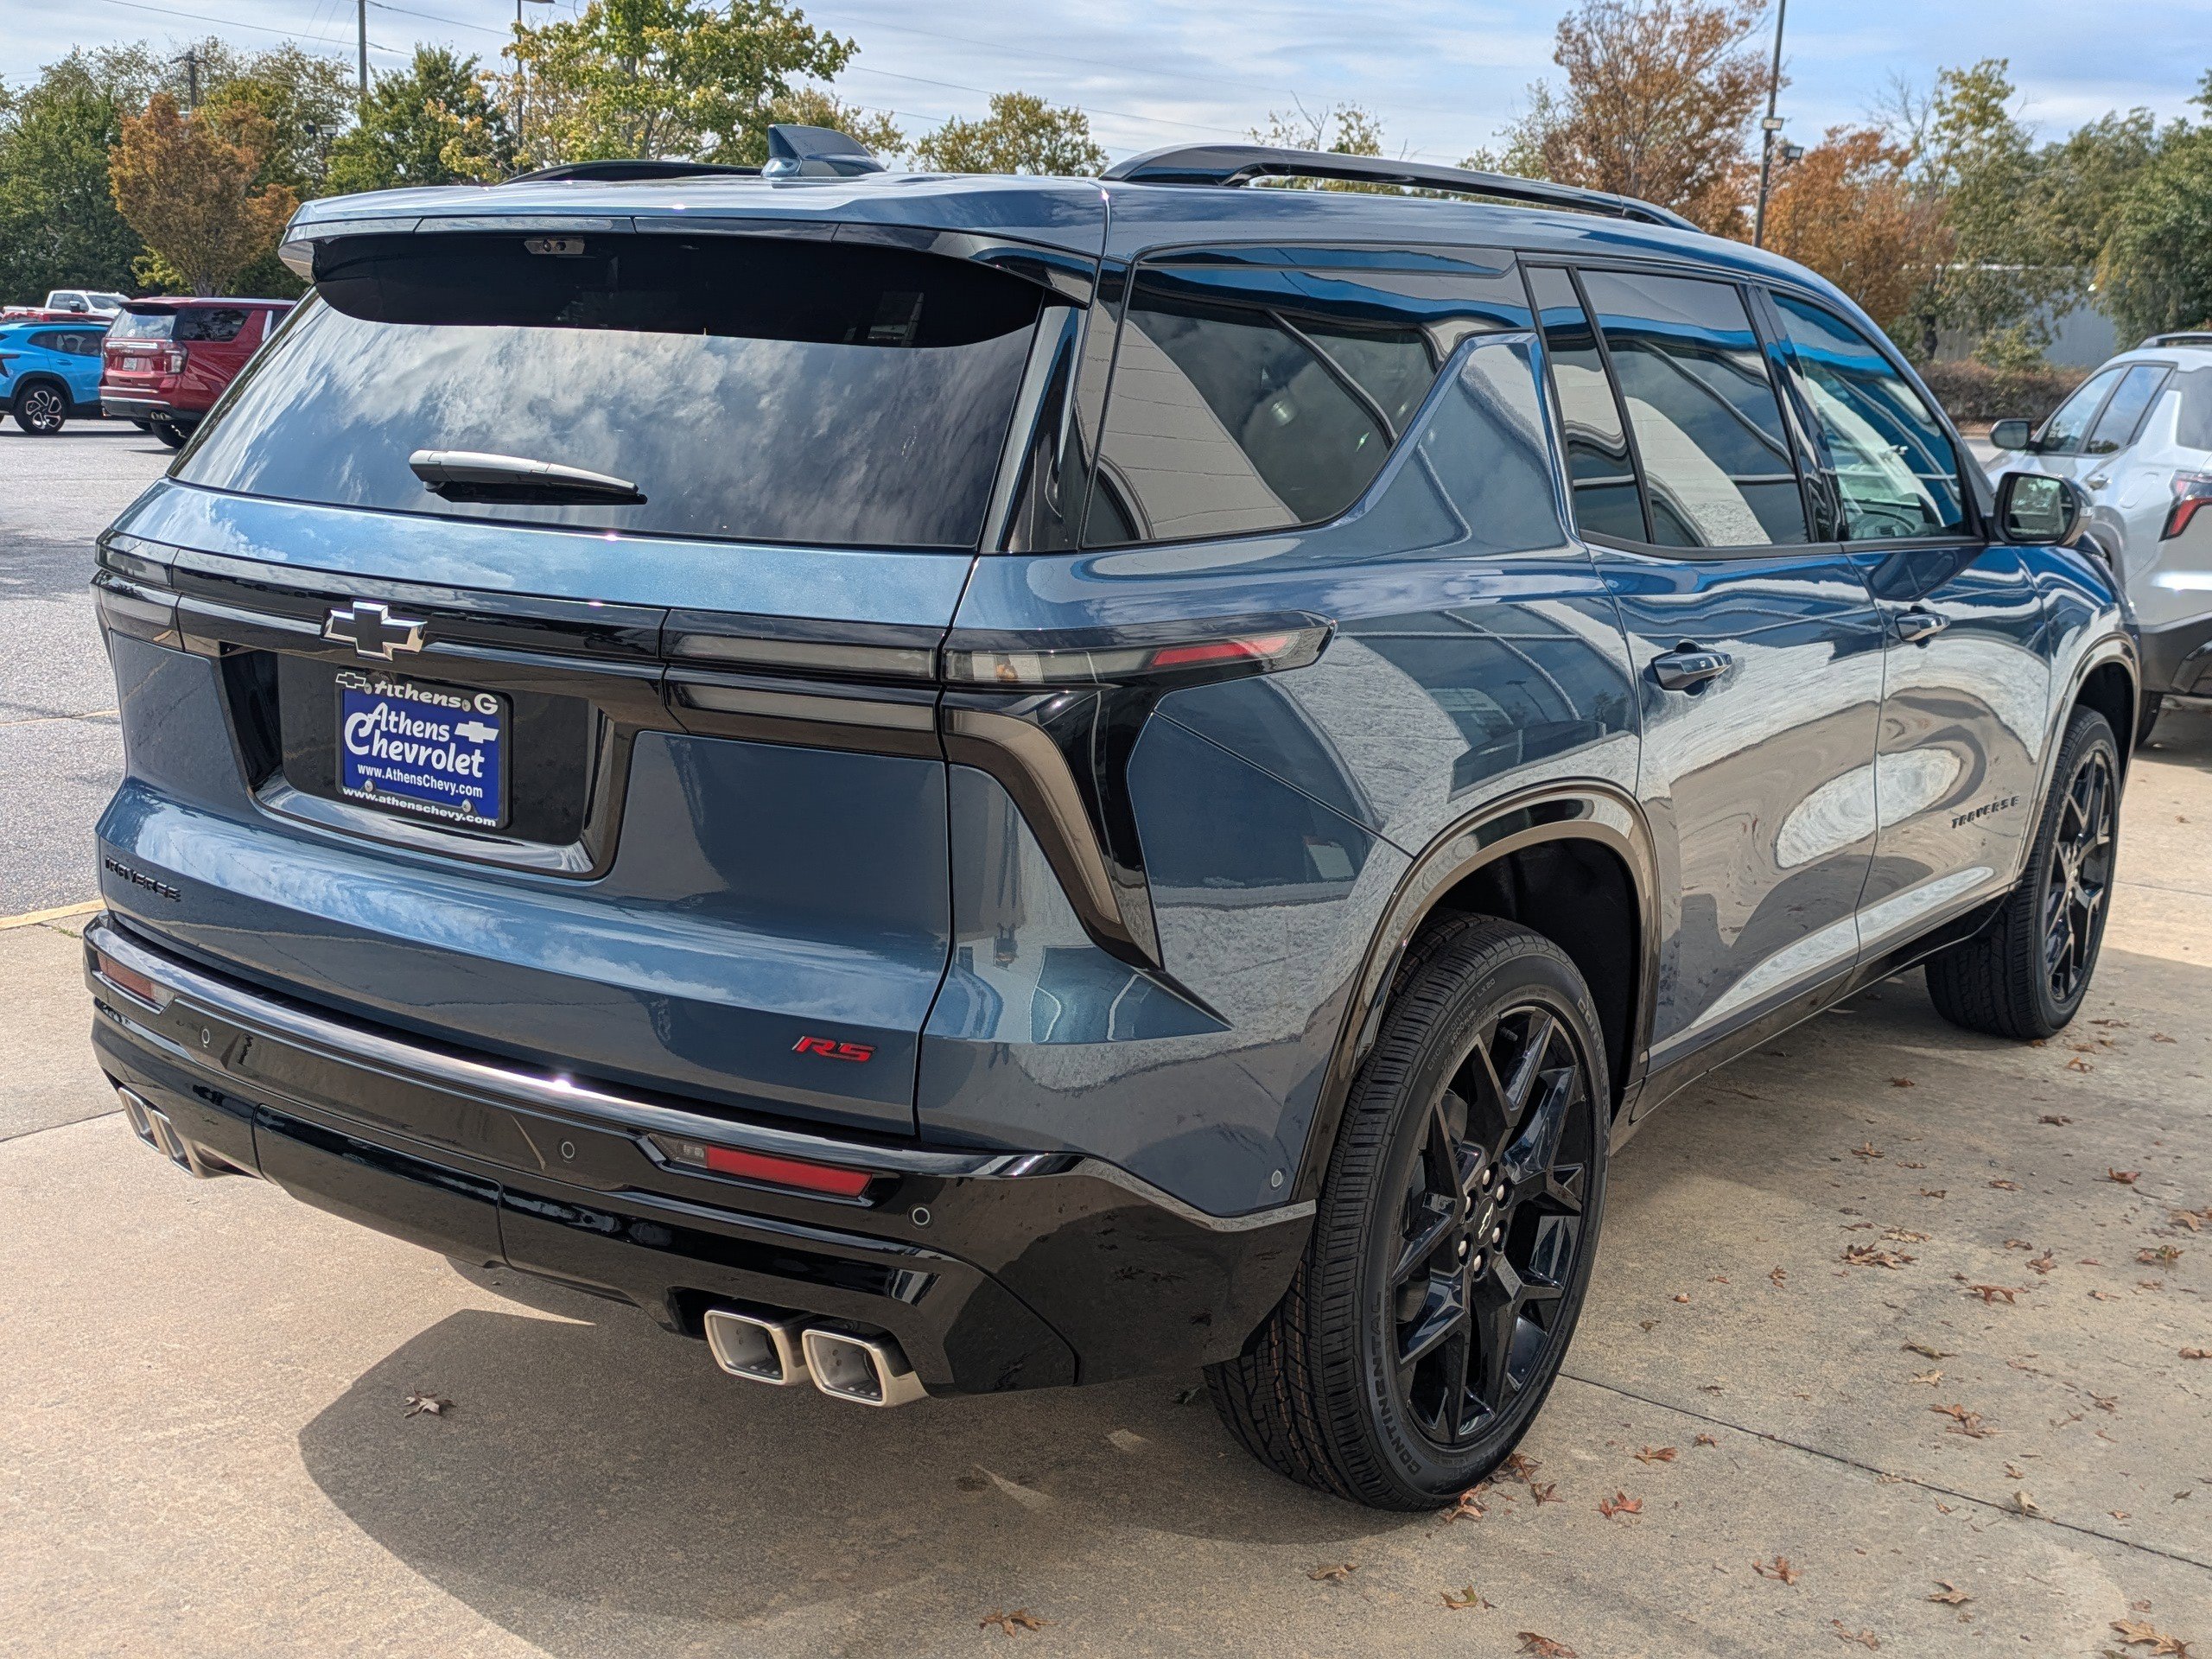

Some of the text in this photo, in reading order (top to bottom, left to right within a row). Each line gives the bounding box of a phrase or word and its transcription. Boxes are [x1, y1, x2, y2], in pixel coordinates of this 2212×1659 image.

[374, 680, 499, 715] Athens G
[361, 702, 450, 742] Athens
[344, 712, 486, 778] Chevrolet
[358, 764, 483, 798] www.AthensChevy.com
[343, 787, 497, 828] www.athenschevy.com
[791, 1036, 876, 1062] RS
